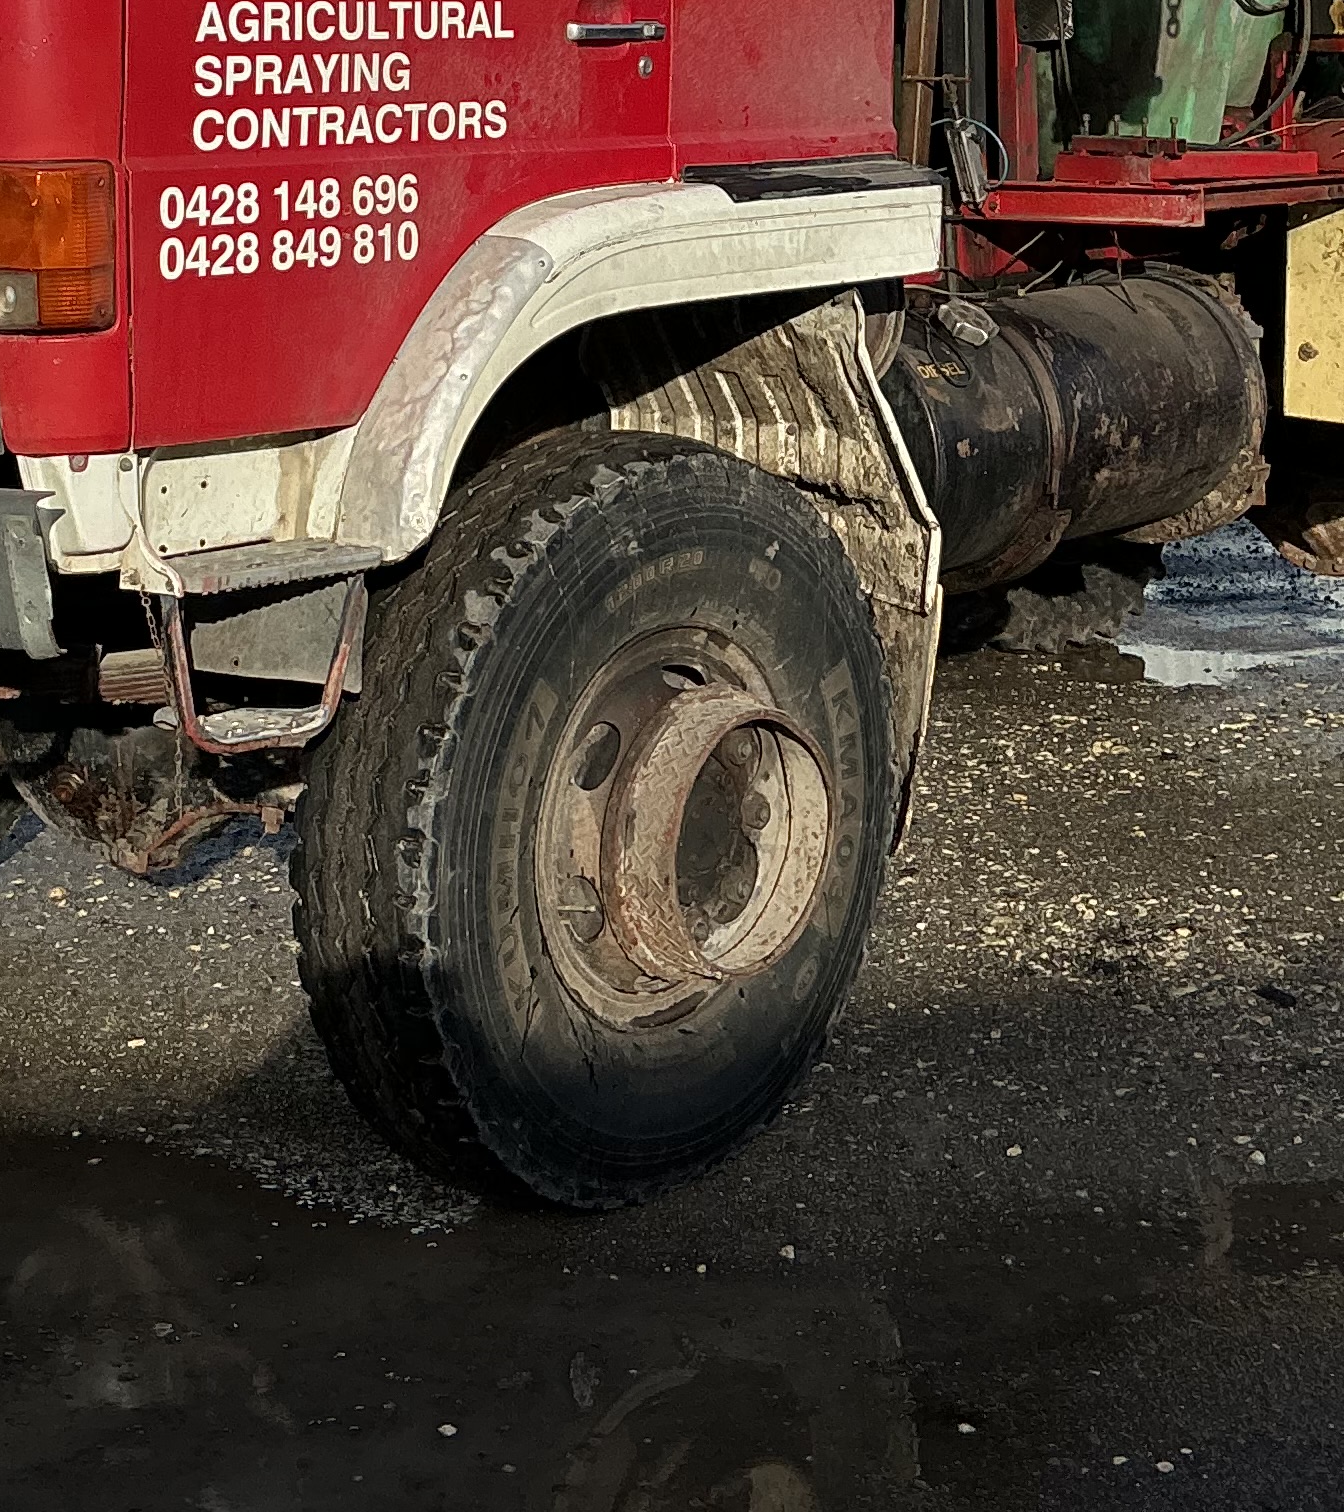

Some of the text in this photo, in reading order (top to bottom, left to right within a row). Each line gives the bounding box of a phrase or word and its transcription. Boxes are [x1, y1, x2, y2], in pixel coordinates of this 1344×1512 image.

[194, 0, 515, 43] AGRICULTURAL
[193, 52, 411, 97] SPRAYING
[192, 99, 507, 152] CONTRACTORS
[159, 173, 419, 229] 0428 148 696
[159, 221, 419, 280] 0428 849 810
